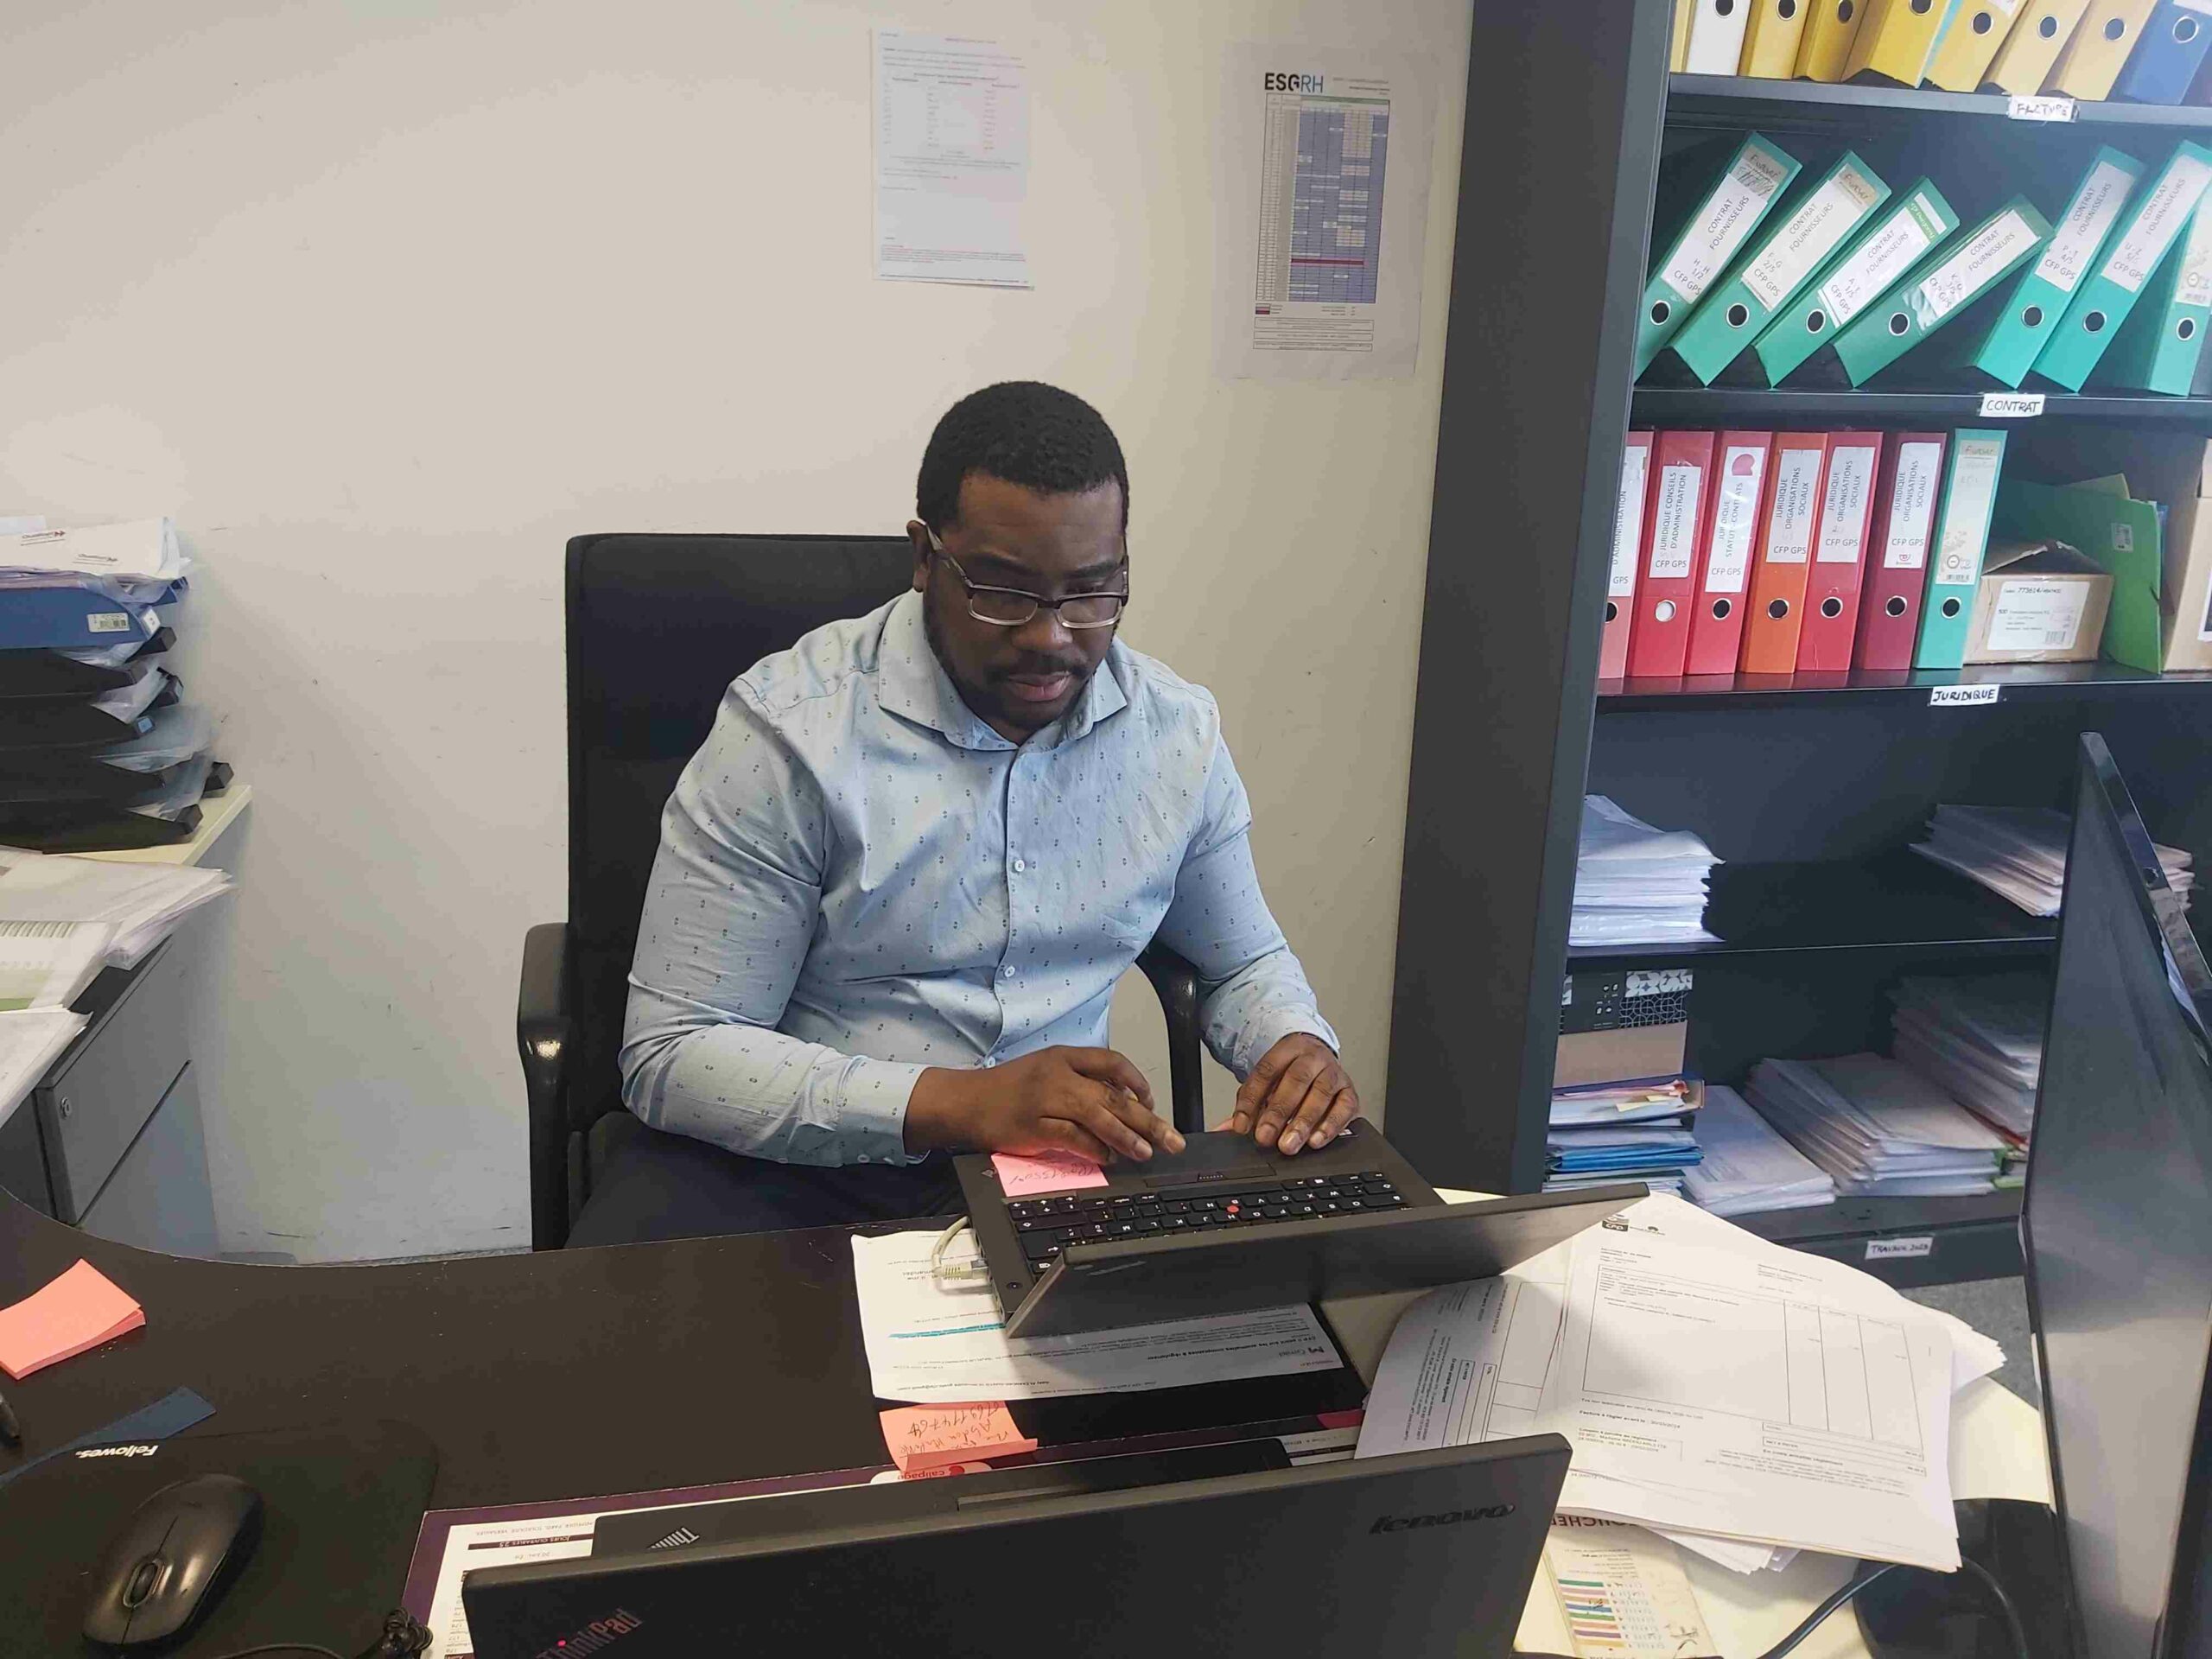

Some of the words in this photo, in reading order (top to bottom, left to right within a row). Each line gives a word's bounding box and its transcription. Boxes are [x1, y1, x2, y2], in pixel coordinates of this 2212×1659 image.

[1264, 72, 1324, 93] ESGRH
[1707, 198, 1733, 234] CONTRAT
[1789, 203, 1818, 235] CONTRAT
[2073, 187, 2096, 221] CONTRAT
[1709, 195, 1750, 251] FOURNISSEURS
[1789, 202, 1834, 252] FOURNISSEURS
[1866, 230, 1896, 258] CONTRAT
[1866, 232, 1910, 275] FOURNISSEURS
[1968, 232, 2015, 272] FOURNISSEURS
[1969, 229, 2000, 256] CONTRAT
[1674, 270, 1688, 286] CFP
[1687, 283, 1702, 296] GPS
[1754, 268, 1767, 285] CFP
[1765, 281, 1782, 297] GPS
[2044, 259, 2060, 272] CFP
[2060, 267, 2076, 281] GPS
[2113, 261, 2129, 272] CFP
[2128, 269, 2145, 282] GPS
[1830, 284, 1843, 300] CFP
[1839, 298, 1852, 315] GPS
[1986, 399, 2041, 412] CONTRAT
[1665, 472, 1677, 508] CONSEILS
[1776, 478, 1788, 518] JURIDIQUE
[1785, 467, 1801, 530] ORGANISATIONS
[1798, 482, 1809, 516] SOCIAUX
[1827, 472, 1840, 511] JURIDIQUE
[1837, 460, 1853, 522] ORGANISATIONS
[1850, 475, 1861, 508] SOCIAUX
[1894, 472, 1906, 512] JURIDIQUE
[1904, 460, 1919, 522] ORGANISATIONS
[1916, 475, 1927, 508] SOCIAUX
[1670, 474, 1687, 549] D'ADMINISTRATION
[1660, 510, 1673, 550] JURIDIQUE
[1842, 538, 1859, 547] GPS
[1908, 538, 1924, 547] GPS
[1790, 546, 1807, 555] GPS
[1932, 689, 1996, 702] JURIDIQUE
[78, 1446, 158, 1459] Fellowes
[1370, 1503, 1516, 1535] lenovo
